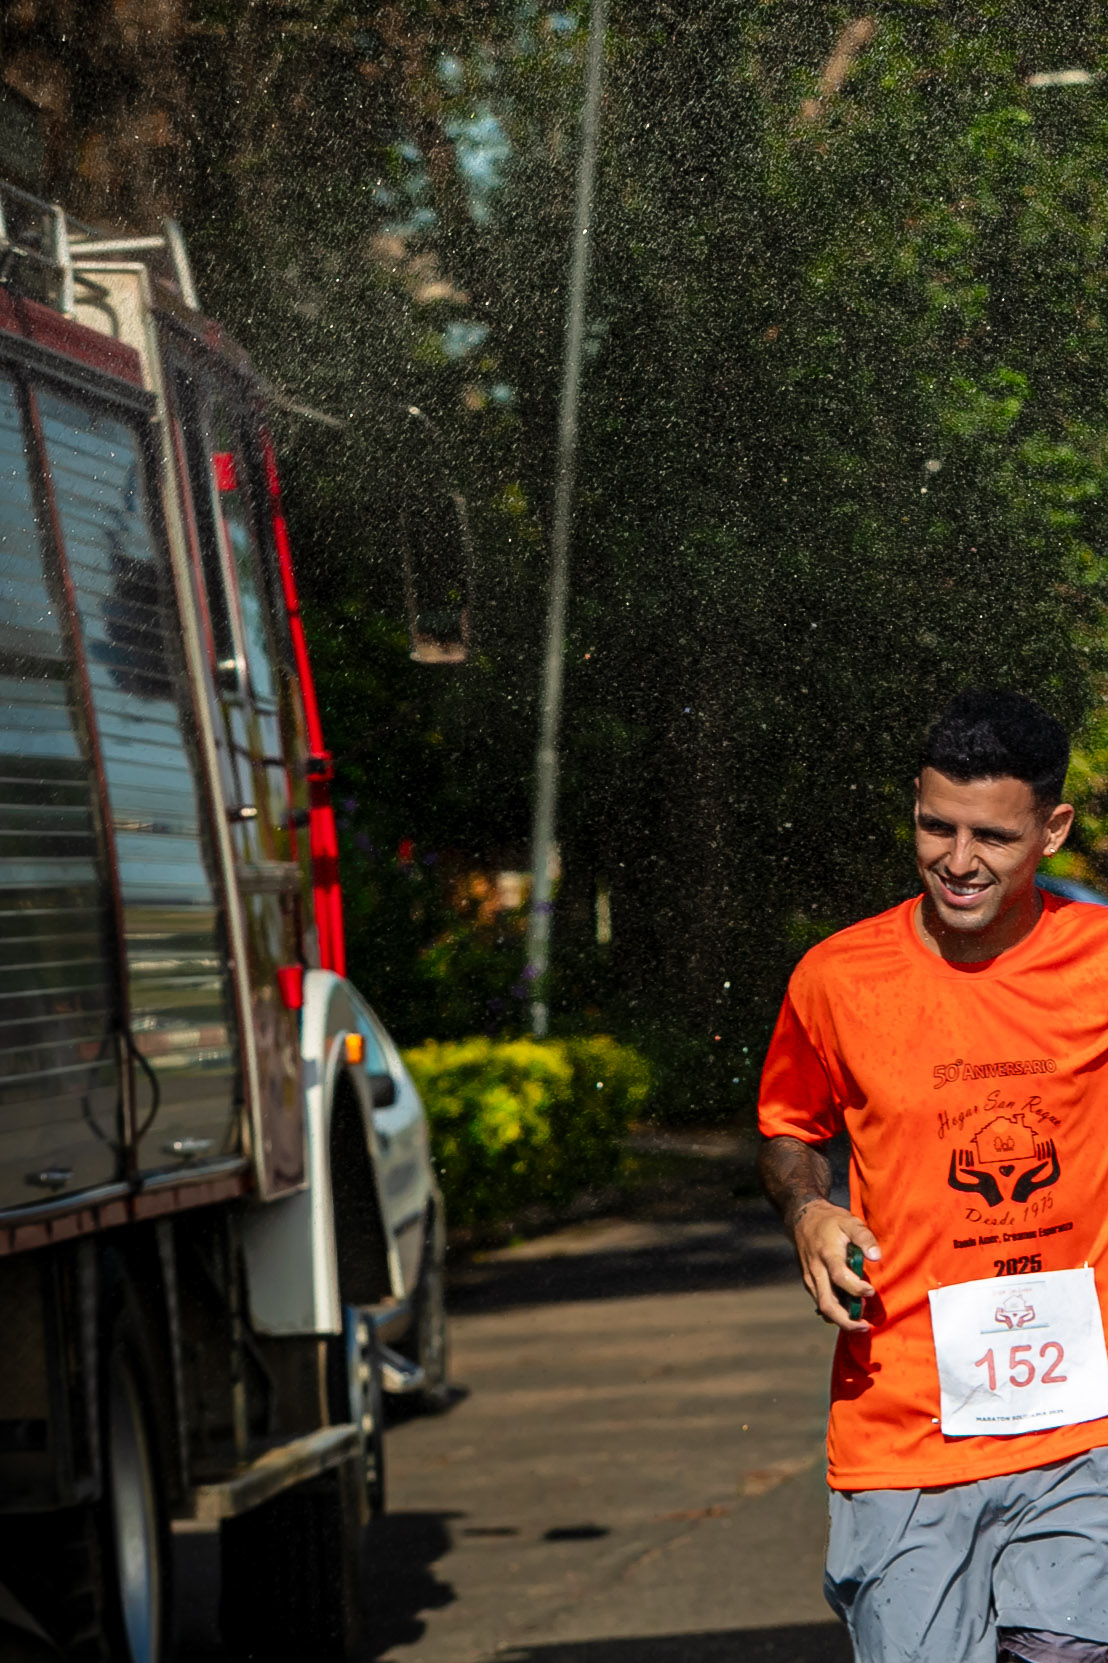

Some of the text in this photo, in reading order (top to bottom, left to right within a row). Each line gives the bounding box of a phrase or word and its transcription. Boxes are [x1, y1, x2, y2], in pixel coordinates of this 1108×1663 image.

[962, 1059, 1056, 1081] ANIVERSARIO
[938, 1090, 1062, 1140] Hogar San Roque
[965, 1190, 1054, 1226] Desde 1975
[994, 1253, 1042, 1277] 2025
[974, 1341, 1068, 1392] 152
